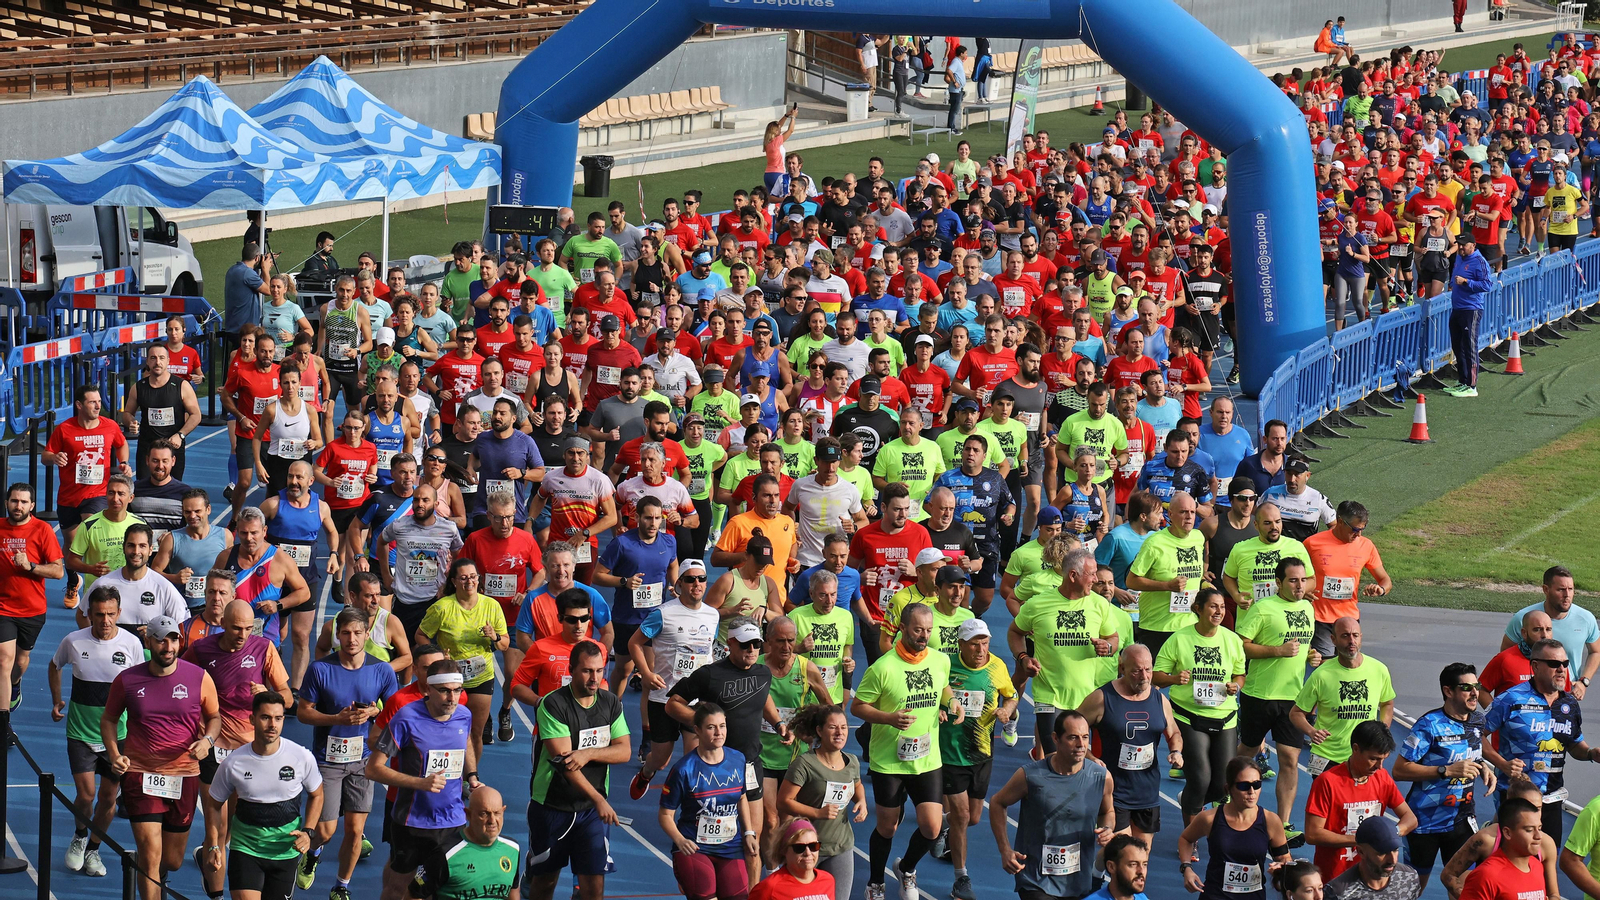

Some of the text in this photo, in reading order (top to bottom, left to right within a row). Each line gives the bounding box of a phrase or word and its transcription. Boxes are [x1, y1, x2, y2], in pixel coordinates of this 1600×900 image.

[51, 213, 72, 226] gescon
[1256, 213, 1274, 323] deportes@aytojerez.es
[150, 413, 163, 421] 163
[705, 433, 717, 441] 527
[281, 445, 294, 453] 245
[79, 469, 92, 478] 397
[408, 565, 423, 574] 727
[189, 582, 204, 591] 355
[488, 581, 503, 589] 498
[1326, 582, 1341, 592] 349
[636, 591, 652, 600] 905
[1256, 588, 1271, 598] 711
[1173, 595, 1190, 605] 275
[1053, 632, 1091, 641] ANIMALS
[1284, 631, 1313, 639] ANIMALS
[809, 651, 840, 659] RUNNING
[678, 659, 694, 670] 880
[1192, 667, 1227, 676] ANIMALS
[1192, 674, 1225, 682] RUNNING
[722, 676, 760, 698] RUN
[906, 692, 938, 703] ANIMALS
[1197, 688, 1214, 697] 816
[905, 701, 937, 710] RUNNING
[1337, 704, 1372, 712] ANIMALS
[1337, 711, 1370, 720] RUNNING
[582, 736, 598, 748] 226
[330, 744, 348, 754] 543
[901, 743, 918, 753] 476
[1127, 751, 1138, 761] 31
[432, 758, 449, 769] 340
[147, 776, 166, 787] 186
[832, 790, 844, 801] 76
[702, 823, 721, 834] 188
[1047, 853, 1067, 865] 865
[1228, 871, 1249, 883] 540
